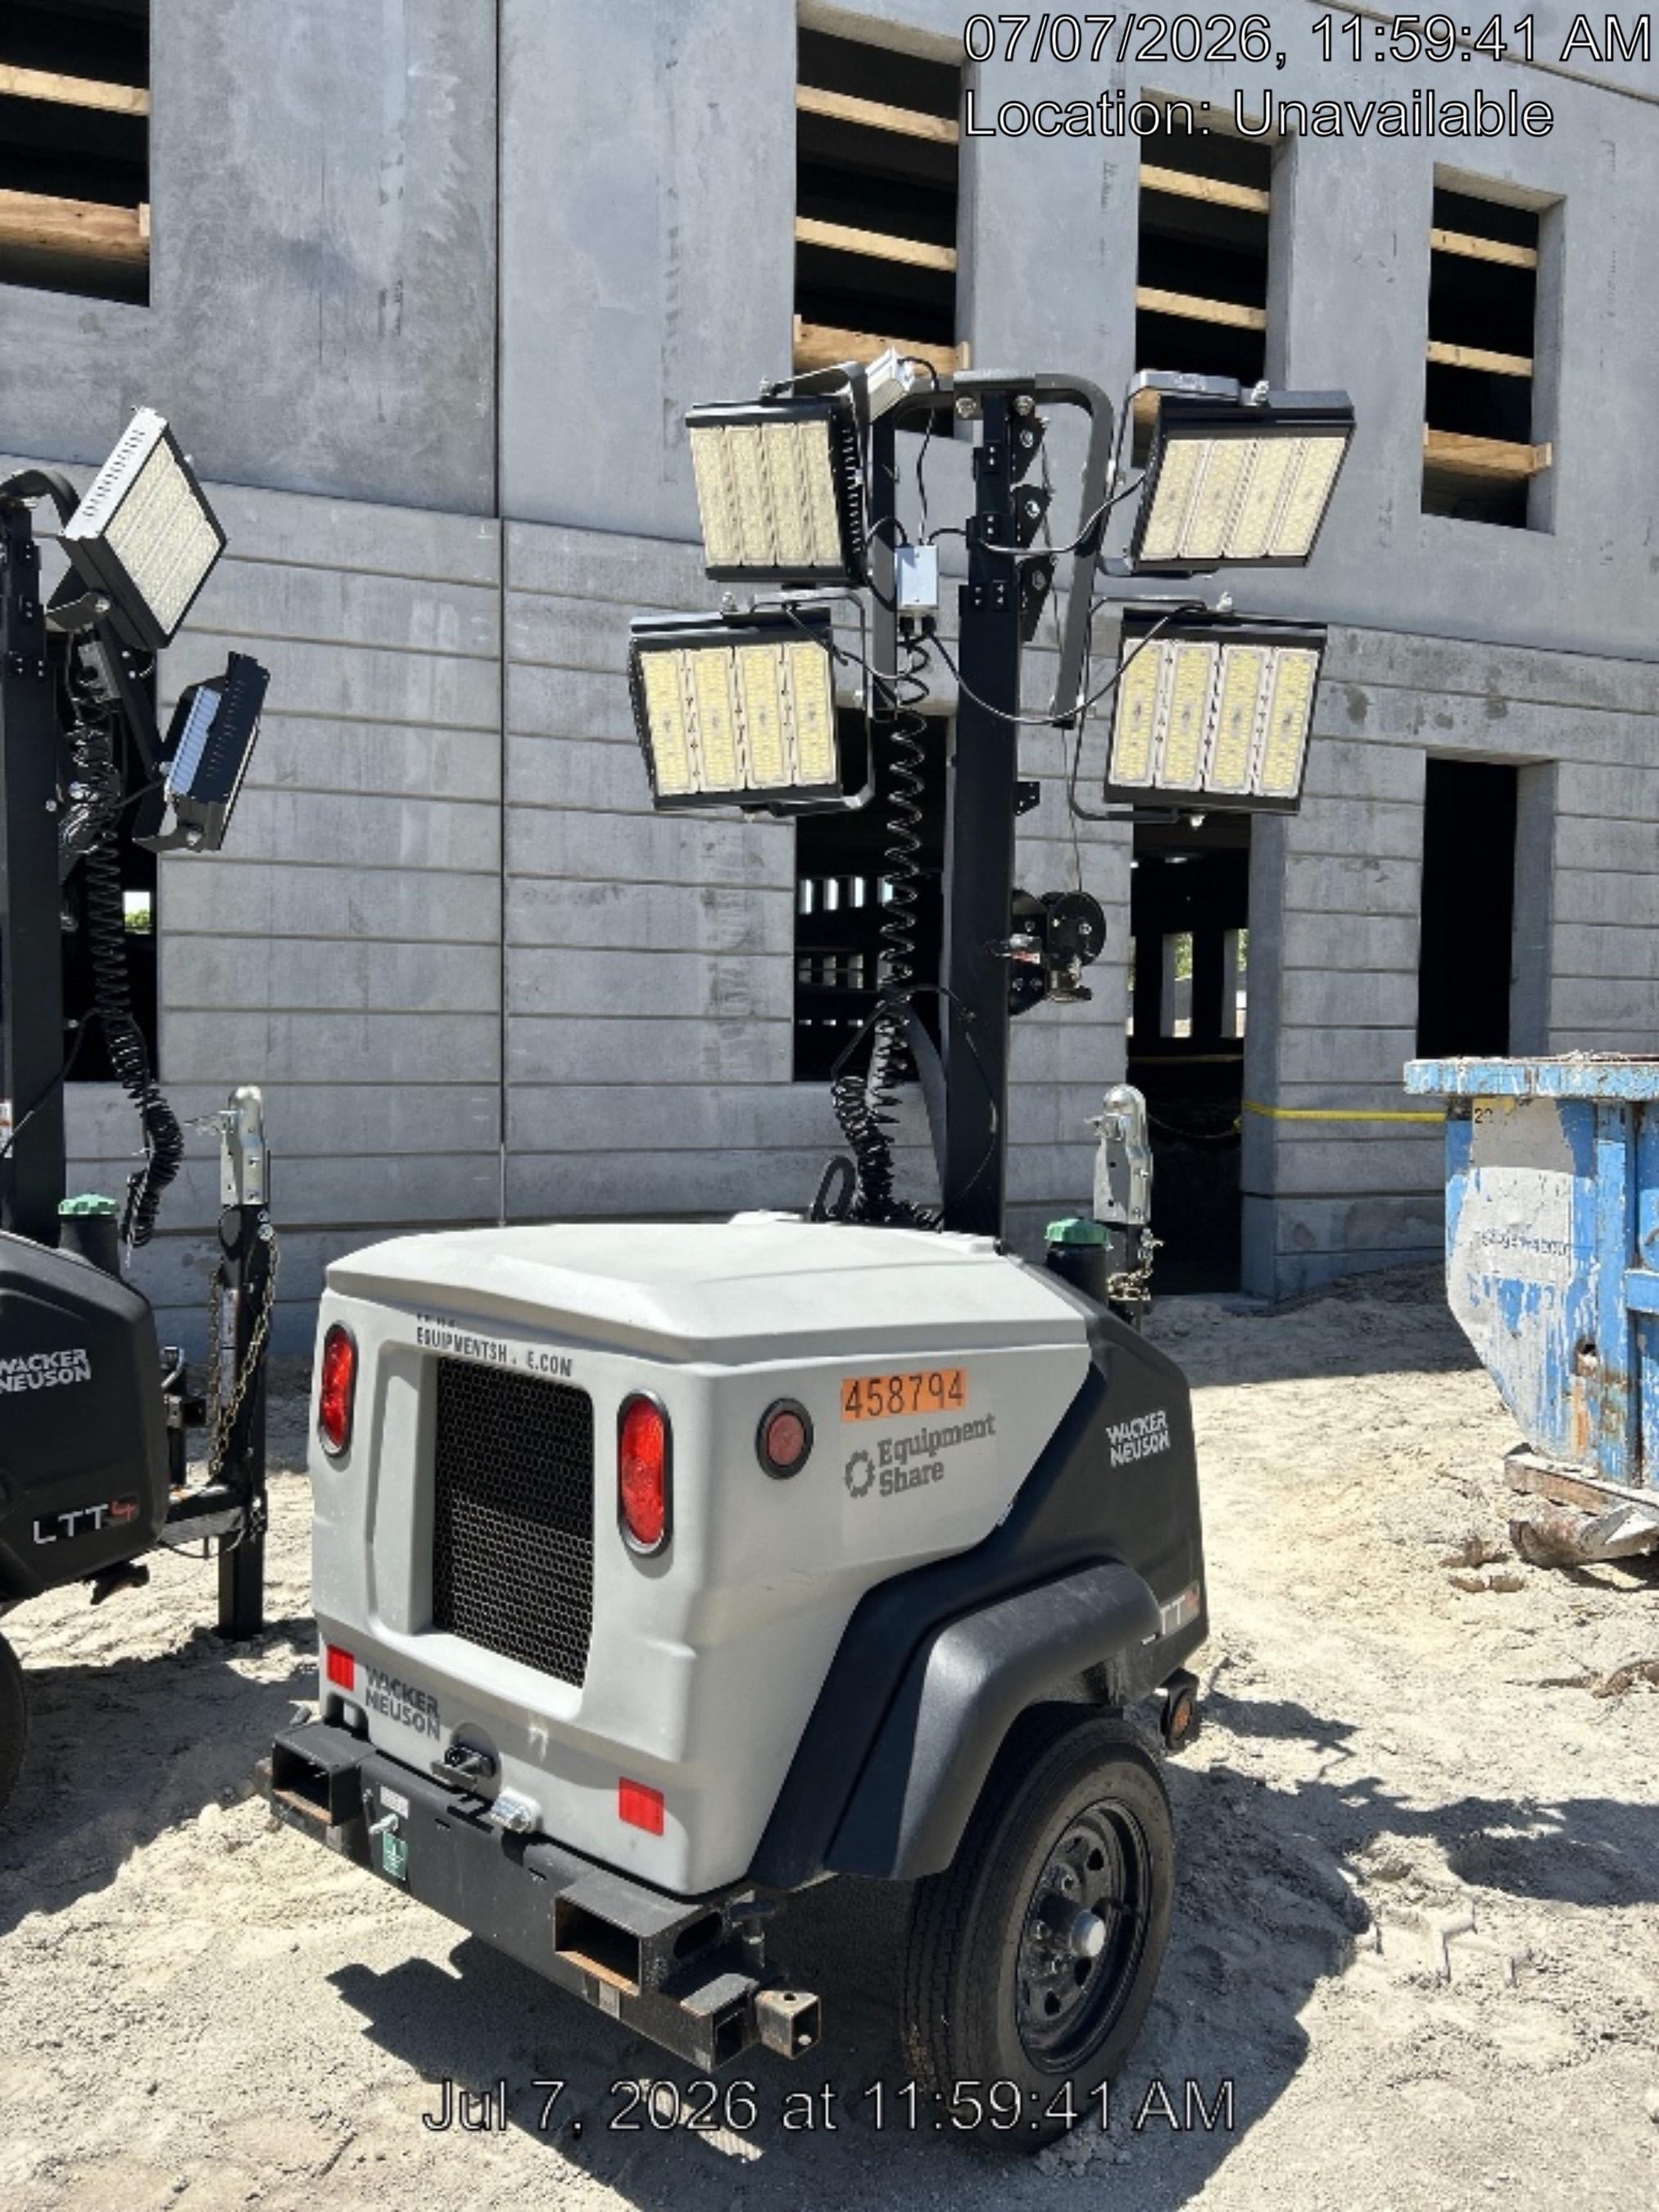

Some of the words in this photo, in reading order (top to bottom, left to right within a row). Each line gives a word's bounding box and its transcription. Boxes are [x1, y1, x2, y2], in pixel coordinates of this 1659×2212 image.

[845, 1370, 963, 1418] 458794
[877, 1412, 995, 1467] Equipment
[1105, 1410, 1169, 1445] WACKER
[1109, 1430, 1172, 1468] NEUSON
[879, 1462, 944, 1497] Share
[32, 1500, 139, 1545] LTT4
[365, 1686, 440, 1741] NEUSON
[366, 1665, 440, 1718] WACKER
